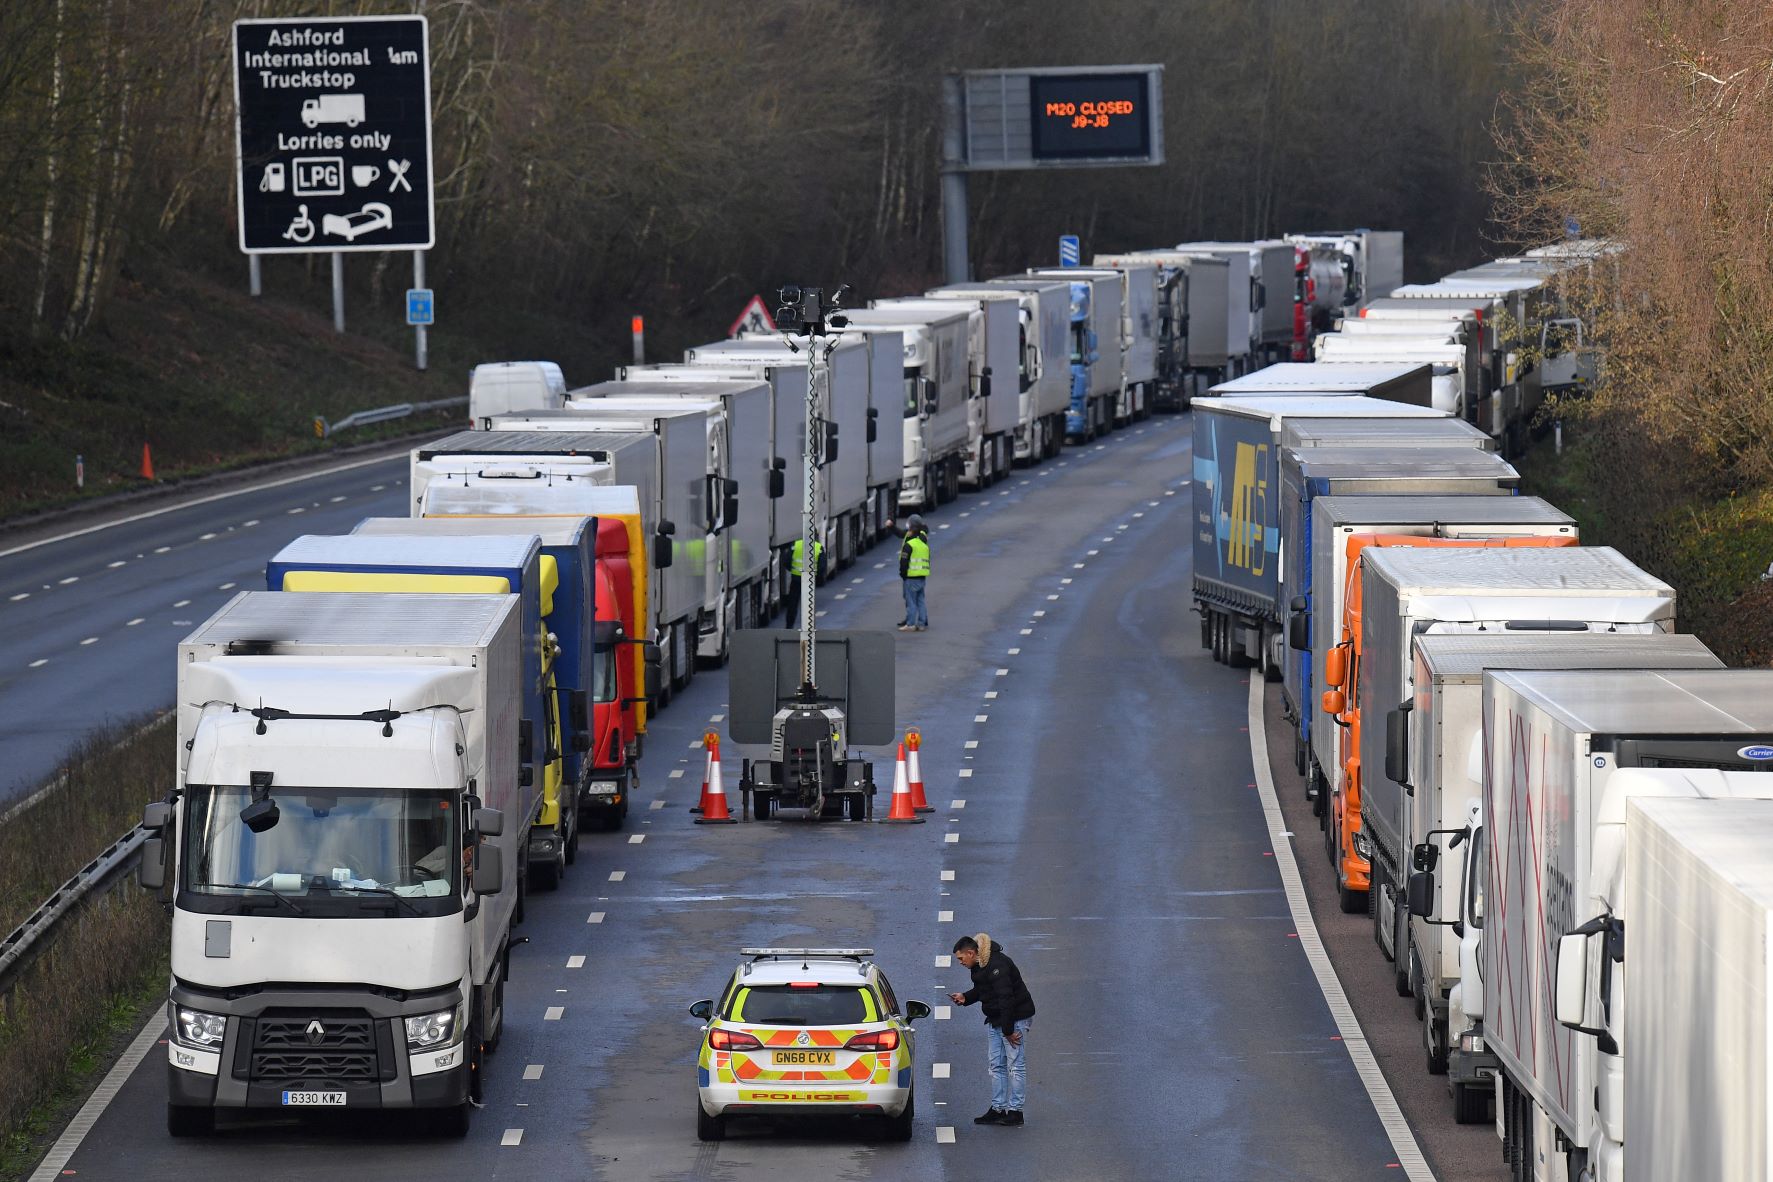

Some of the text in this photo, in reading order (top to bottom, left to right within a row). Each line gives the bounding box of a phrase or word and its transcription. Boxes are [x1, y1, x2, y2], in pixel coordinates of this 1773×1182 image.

[268, 28, 344, 46] Ashford
[245, 48, 371, 68] International
[259, 70, 355, 89] Truckstop
[1046, 101, 1133, 117] M20 CLOSED
[1071, 114, 1109, 128] J9-J8
[278, 131, 391, 151] Lorries only
[298, 166, 338, 188] LPG
[776, 1052, 831, 1063] GN68 CVX
[291, 1093, 343, 1104] 6330 KWZ
